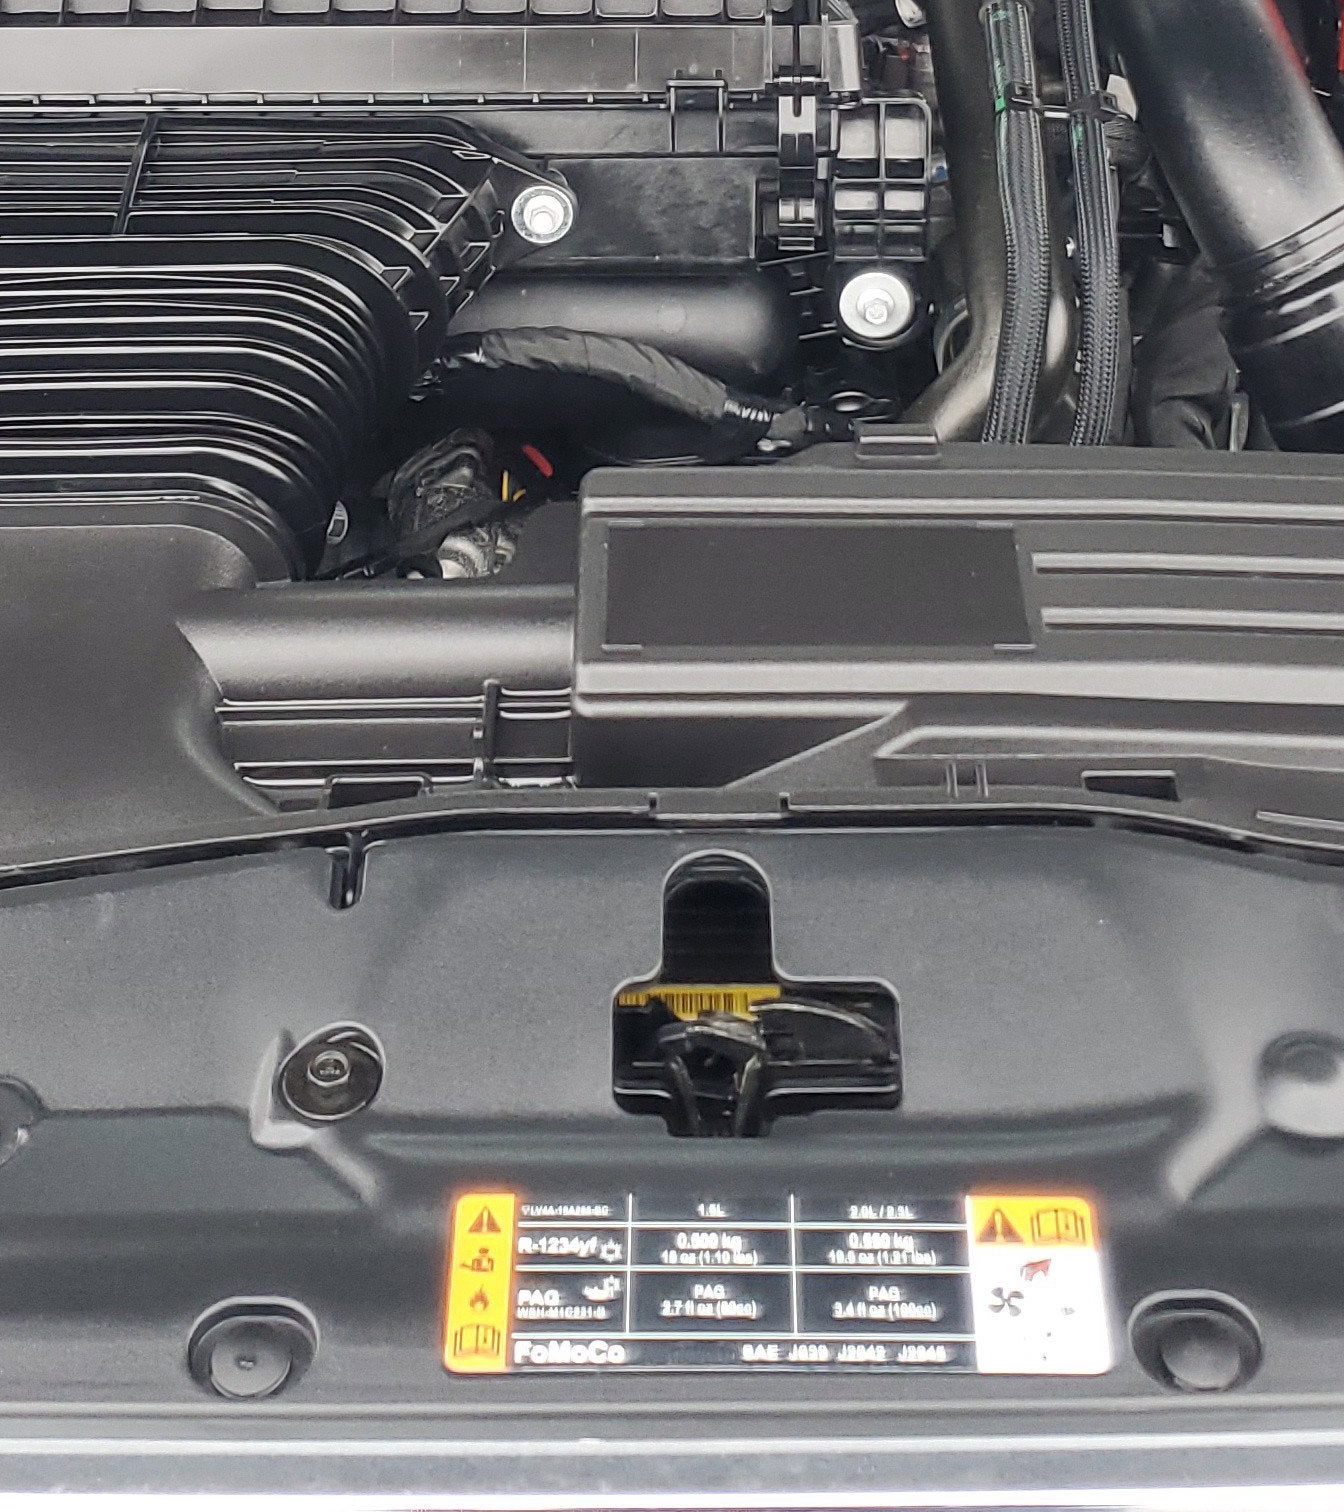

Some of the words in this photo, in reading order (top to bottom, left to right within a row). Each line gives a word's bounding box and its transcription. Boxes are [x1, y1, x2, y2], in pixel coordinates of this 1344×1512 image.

[517, 1236, 597, 1256] R-1234yf
[517, 1289, 560, 1306] PAG
[693, 1284, 726, 1299] PAG
[868, 1286, 902, 1301] PAG
[513, 1340, 626, 1365] FoMoCo
[742, 1344, 780, 1362] SAE
